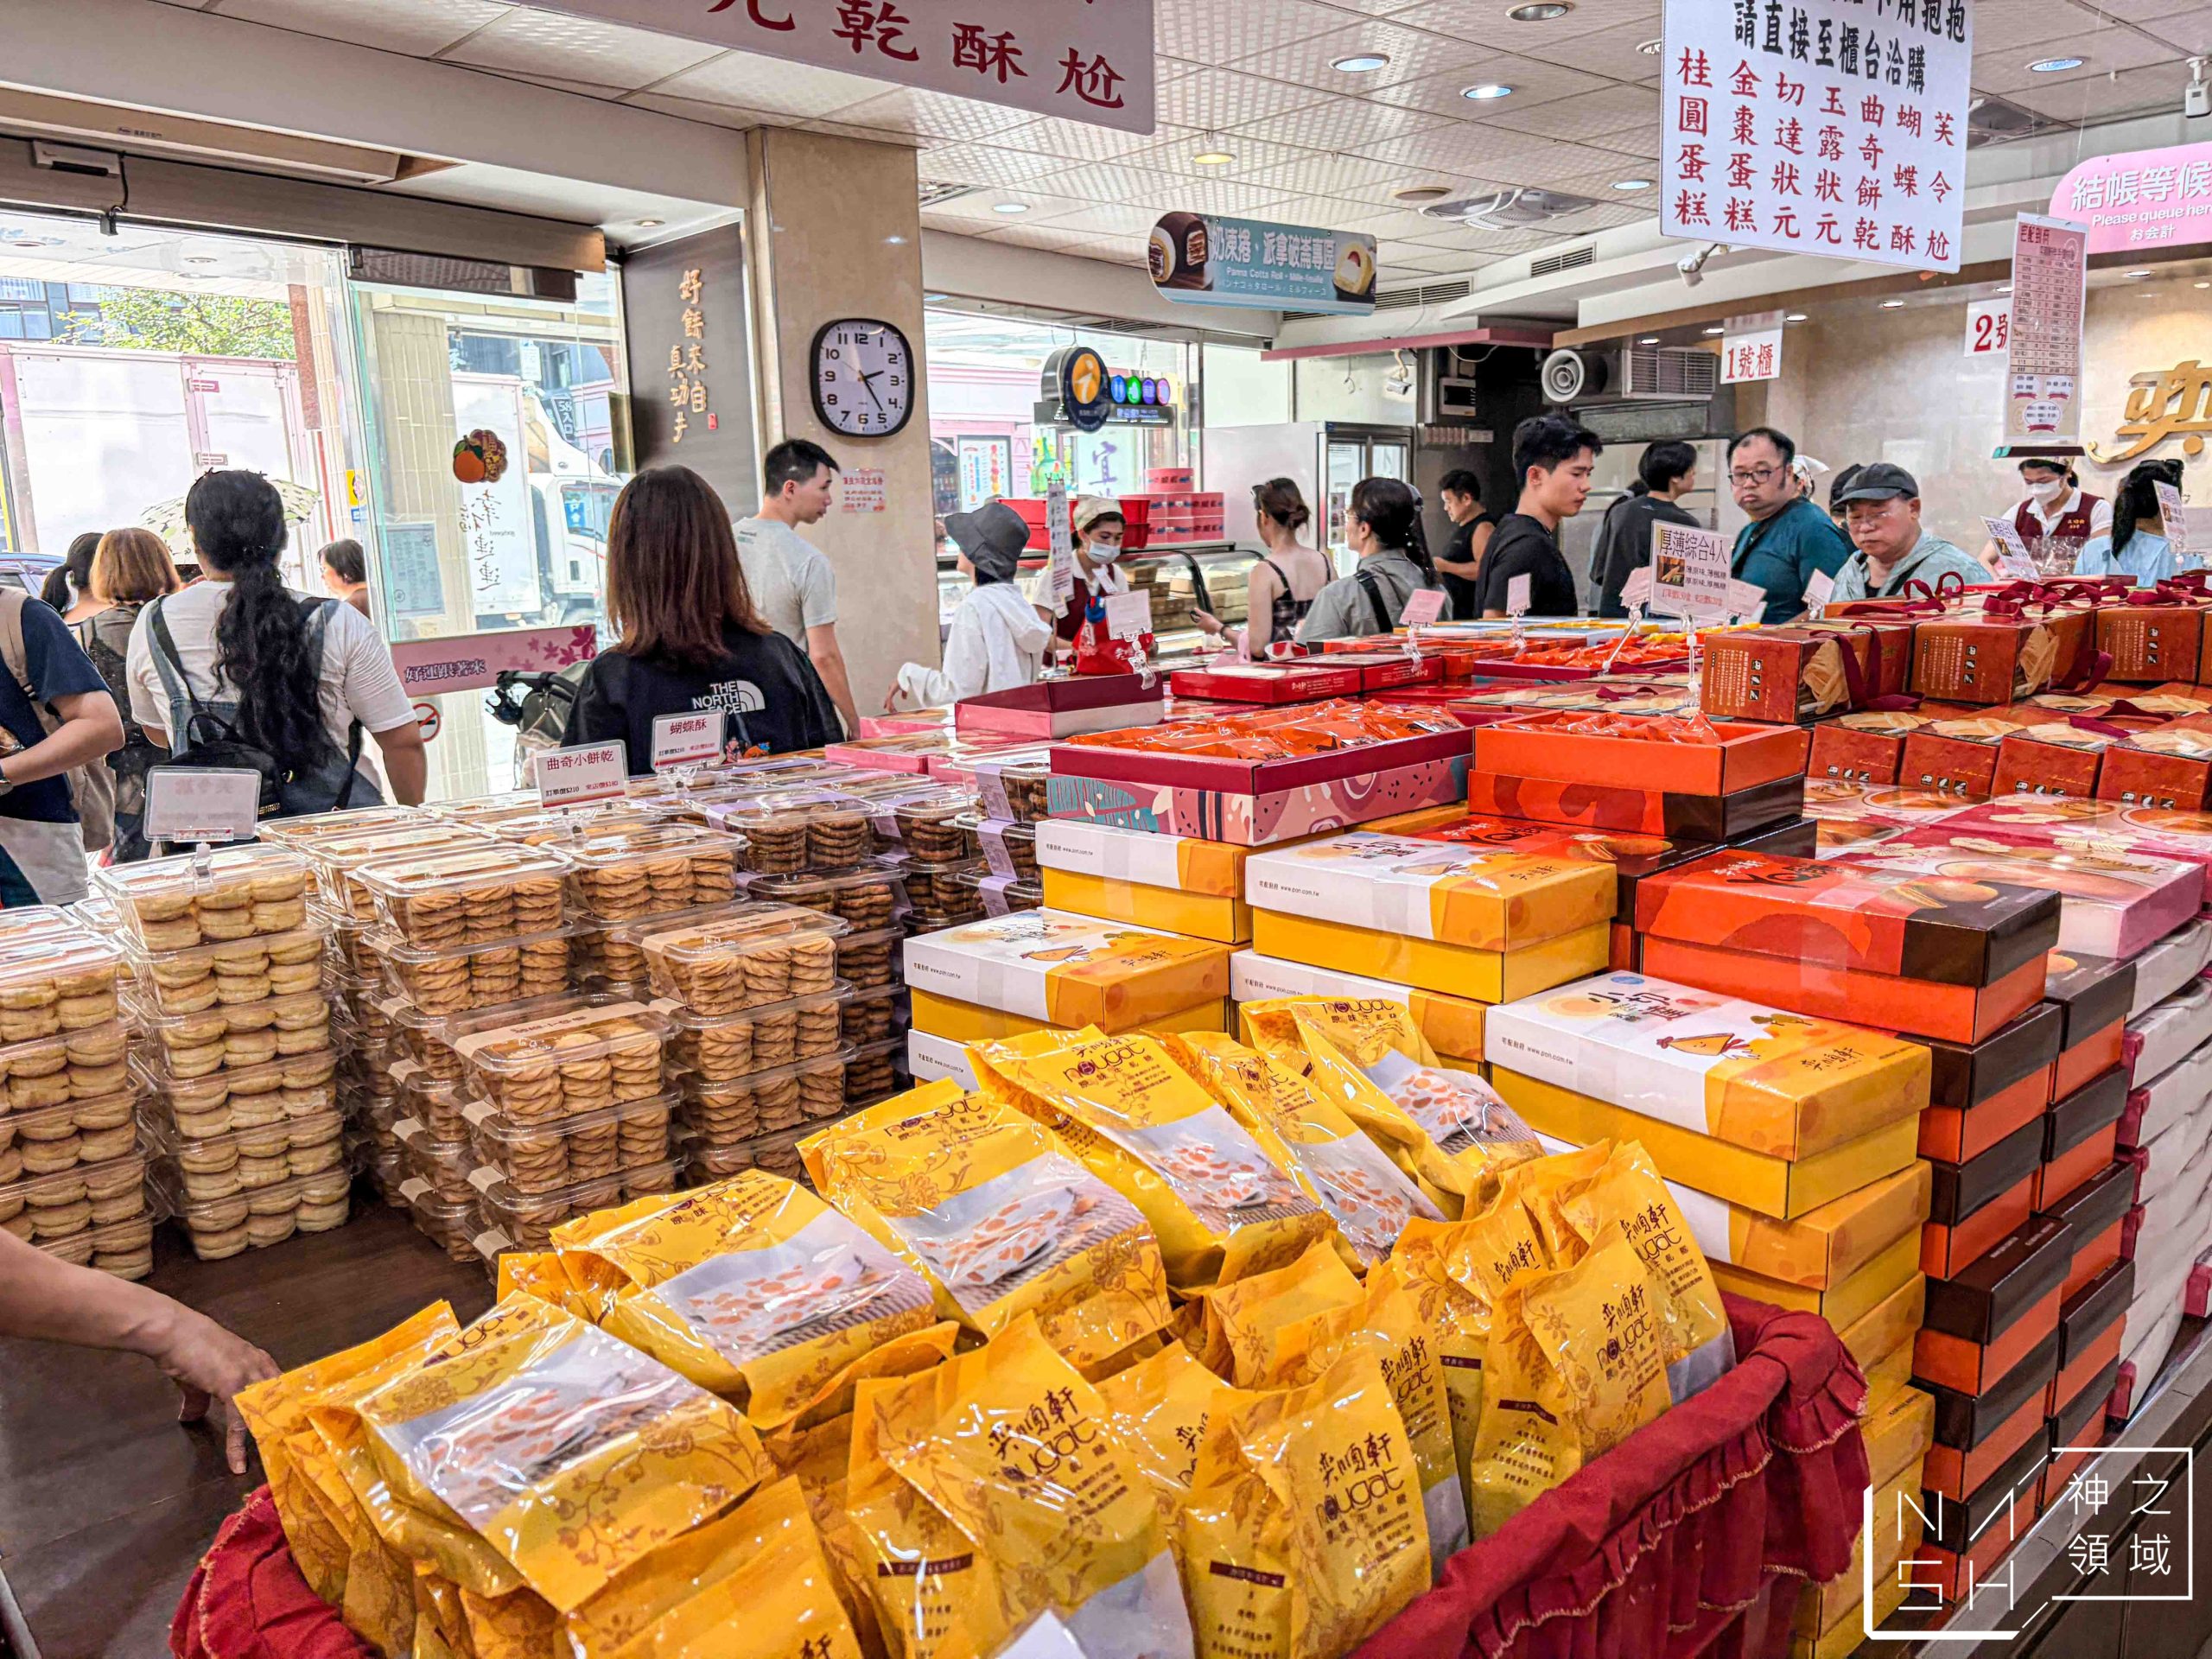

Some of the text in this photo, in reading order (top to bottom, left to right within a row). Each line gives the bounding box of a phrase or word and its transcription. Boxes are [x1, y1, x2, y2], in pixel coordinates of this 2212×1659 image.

[1674, 47, 1713, 226] 桂圓蛋糕
[1723, 60, 1762, 233] 金棗蛋糕
[1771, 72, 1806, 239] 切達狀元
[1815, 86, 1847, 245] 玉露狀元
[1853, 94, 1886, 251] 曲奇餅乾
[1890, 104, 1922, 256] 蝴蝶酥
[1924, 111, 1955, 262] 芙令尬
[2071, 161, 2212, 212] 結帳等候
[2092, 212, 2136, 227] Please
[2139, 207, 2184, 223] queue
[2130, 225, 2176, 242] お会計
[838, 333, 848, 345] 11
[855, 333, 868, 345] 12
[879, 337, 884, 347] 1
[826, 348, 840, 359] 10
[888, 353, 898, 364] 2
[1726, 343, 1775, 380] 1號櫃
[825, 371, 836, 382] 9
[890, 375, 899, 386] 3
[827, 394, 838, 405] 8
[888, 398, 898, 409] 4
[841, 410, 851, 422] 7
[858, 413, 868, 424] 6
[877, 413, 887, 423] 5
[709, 680, 737, 695] THE
[692, 692, 740, 709] NORTH
[670, 718, 707, 735] 蝴蝶酥
[547, 750, 614, 771] 曲奇小餅乾
